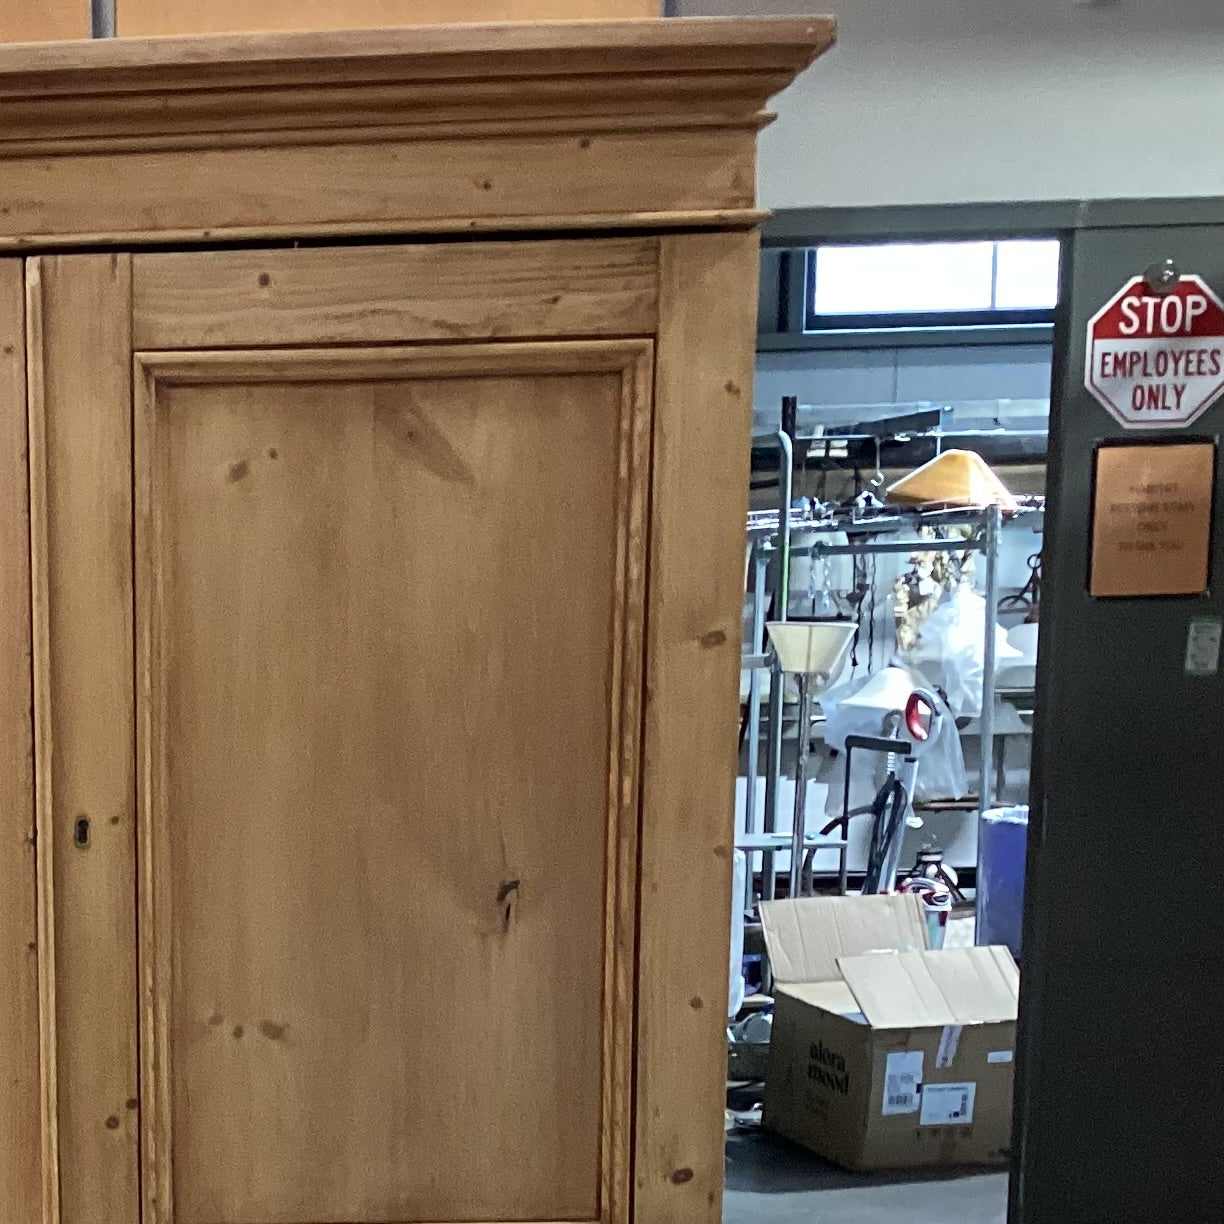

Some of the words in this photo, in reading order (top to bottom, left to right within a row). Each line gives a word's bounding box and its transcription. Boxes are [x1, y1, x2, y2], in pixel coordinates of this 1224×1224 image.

[1118, 295, 1207, 335] STOP
[1100, 349, 1221, 378] EMPLOYEES
[1131, 384, 1187, 411] ONLY
